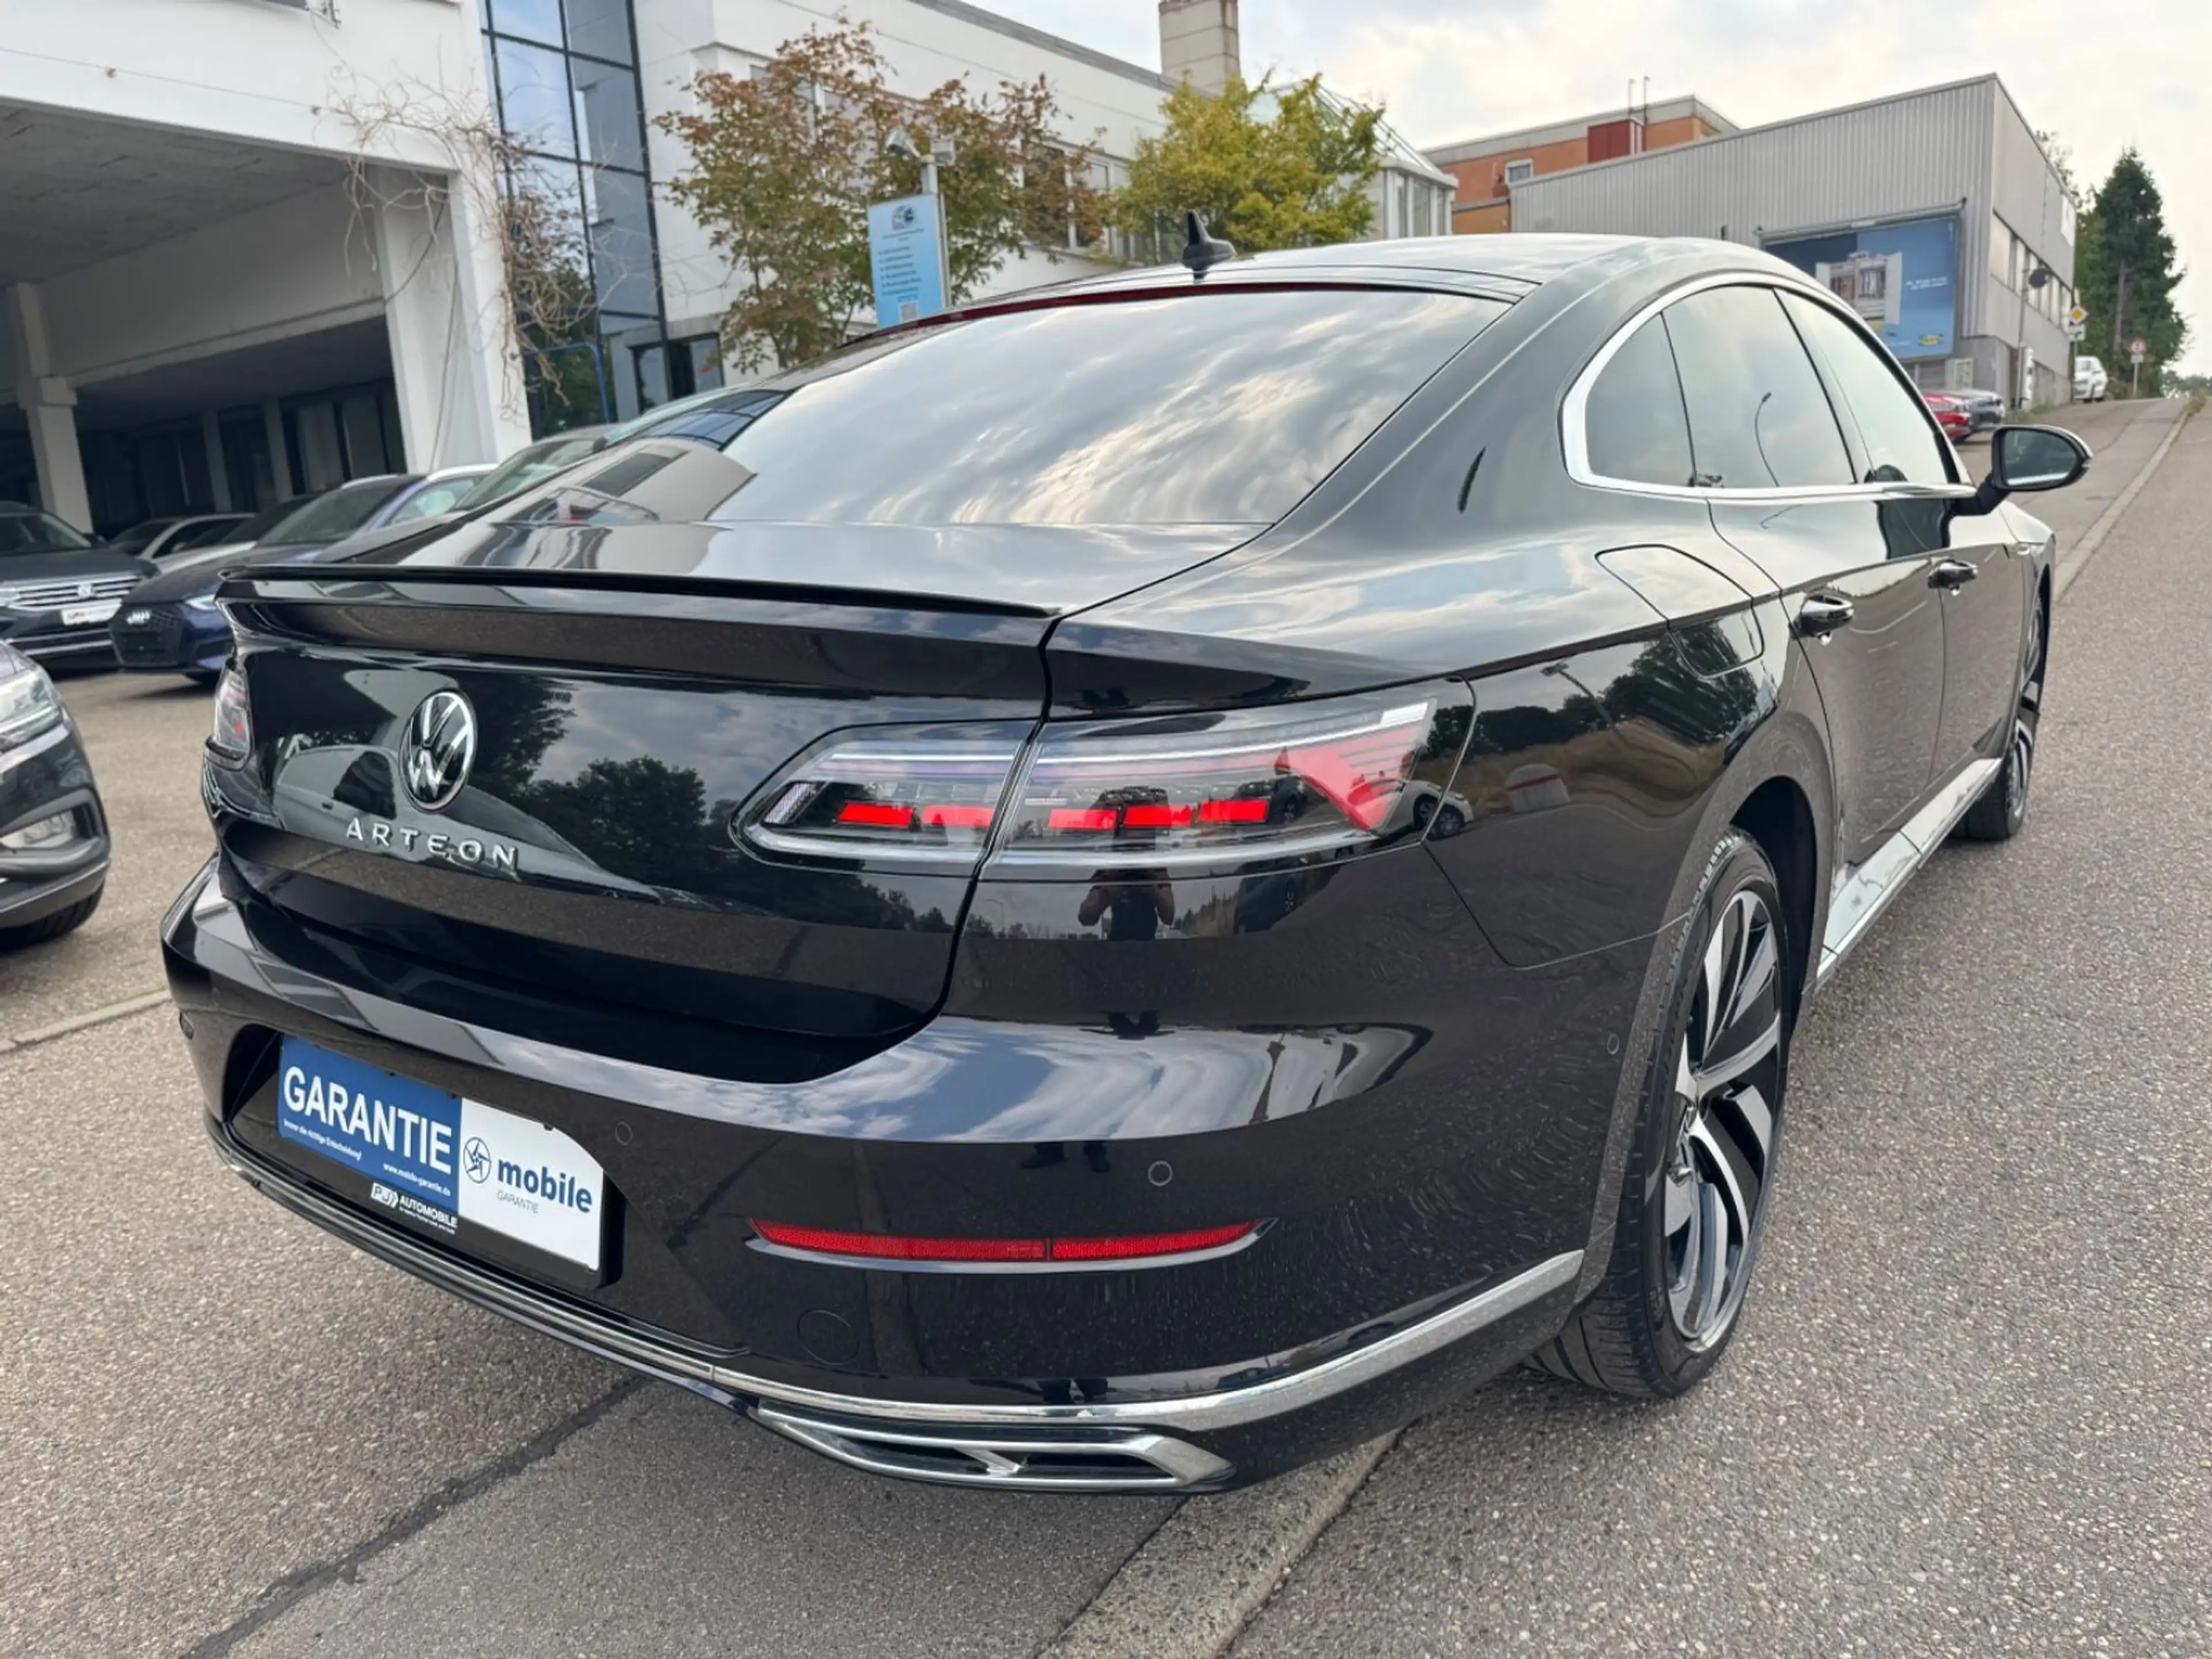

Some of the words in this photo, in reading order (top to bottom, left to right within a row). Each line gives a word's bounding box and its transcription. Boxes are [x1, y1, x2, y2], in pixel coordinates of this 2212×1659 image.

[346, 817, 518, 871] ARTEON
[283, 1066, 452, 1175] GARANTIE
[399, 1195, 459, 1229] AUTOMOBILE
[497, 1190, 540, 1214] GARANTIE
[498, 1159, 593, 1214] mobile
